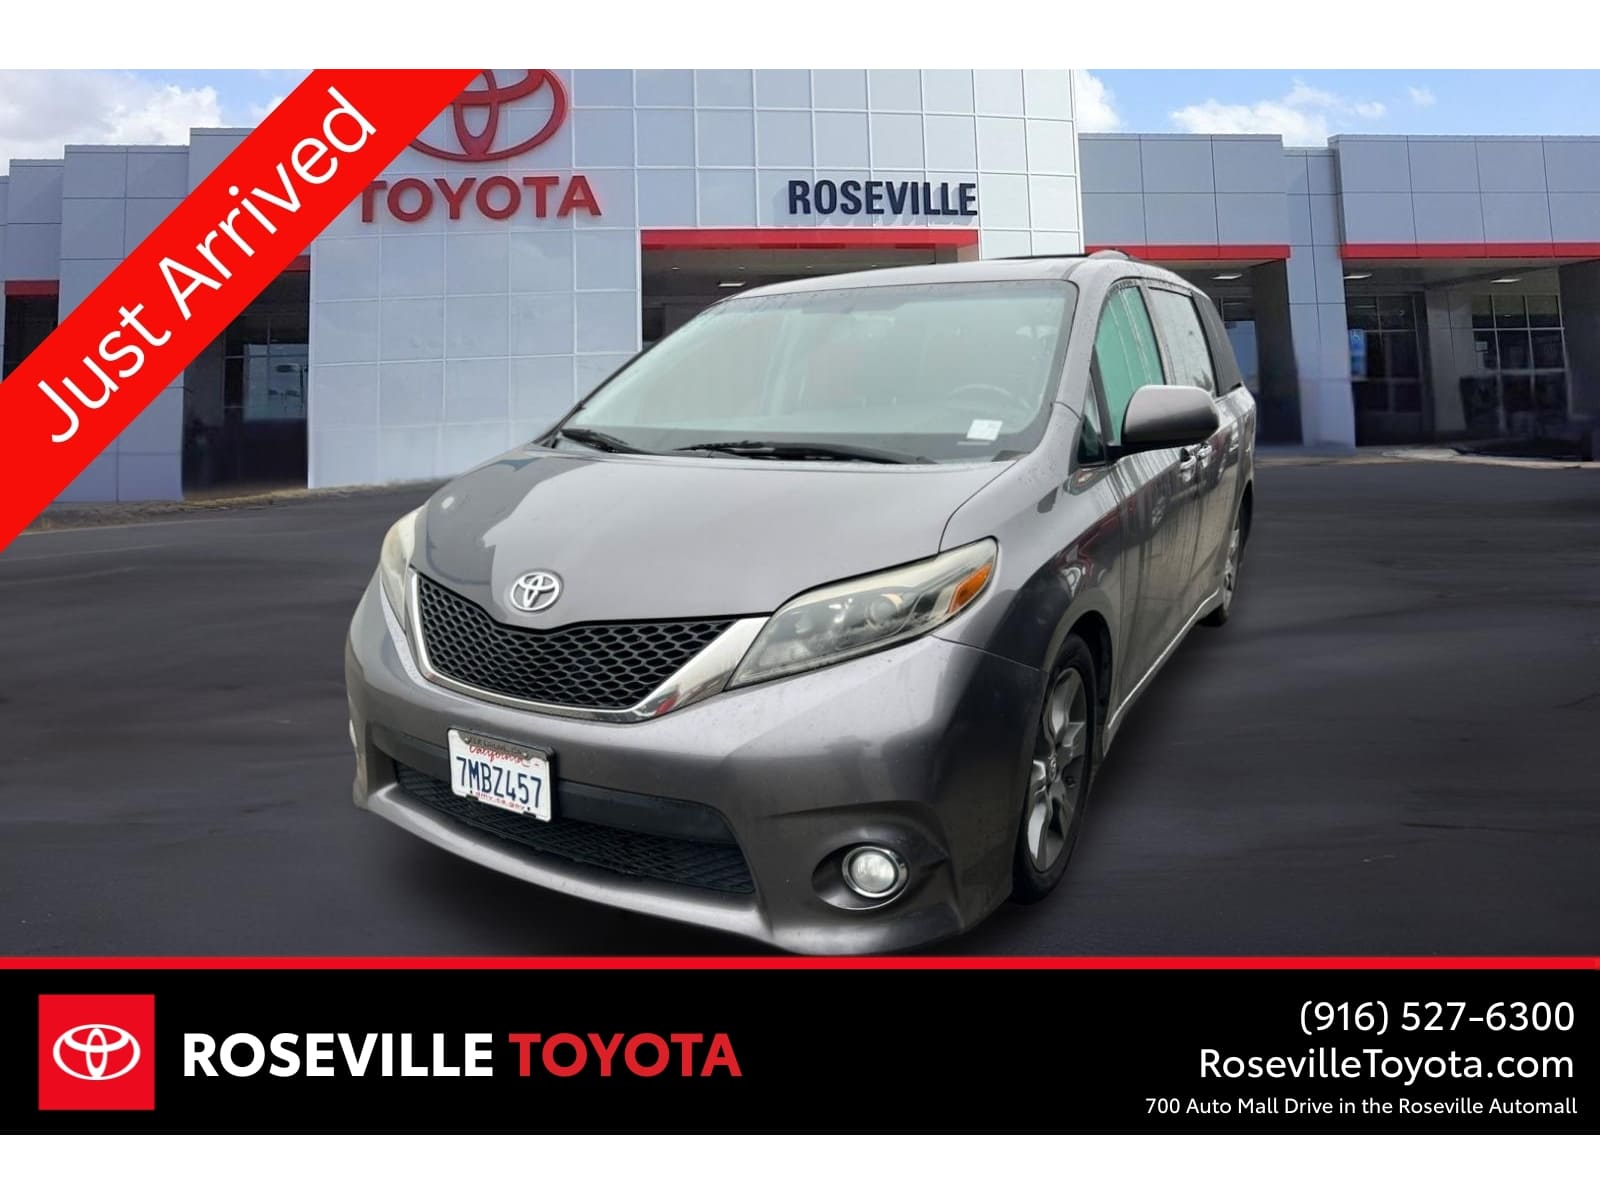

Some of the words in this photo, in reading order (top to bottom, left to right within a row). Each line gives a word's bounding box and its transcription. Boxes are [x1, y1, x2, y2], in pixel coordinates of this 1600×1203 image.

[361, 175, 602, 223] TOYOTA
[788, 179, 978, 217] ROSEVILLE
[456, 756, 542, 808] 7MBZ457
